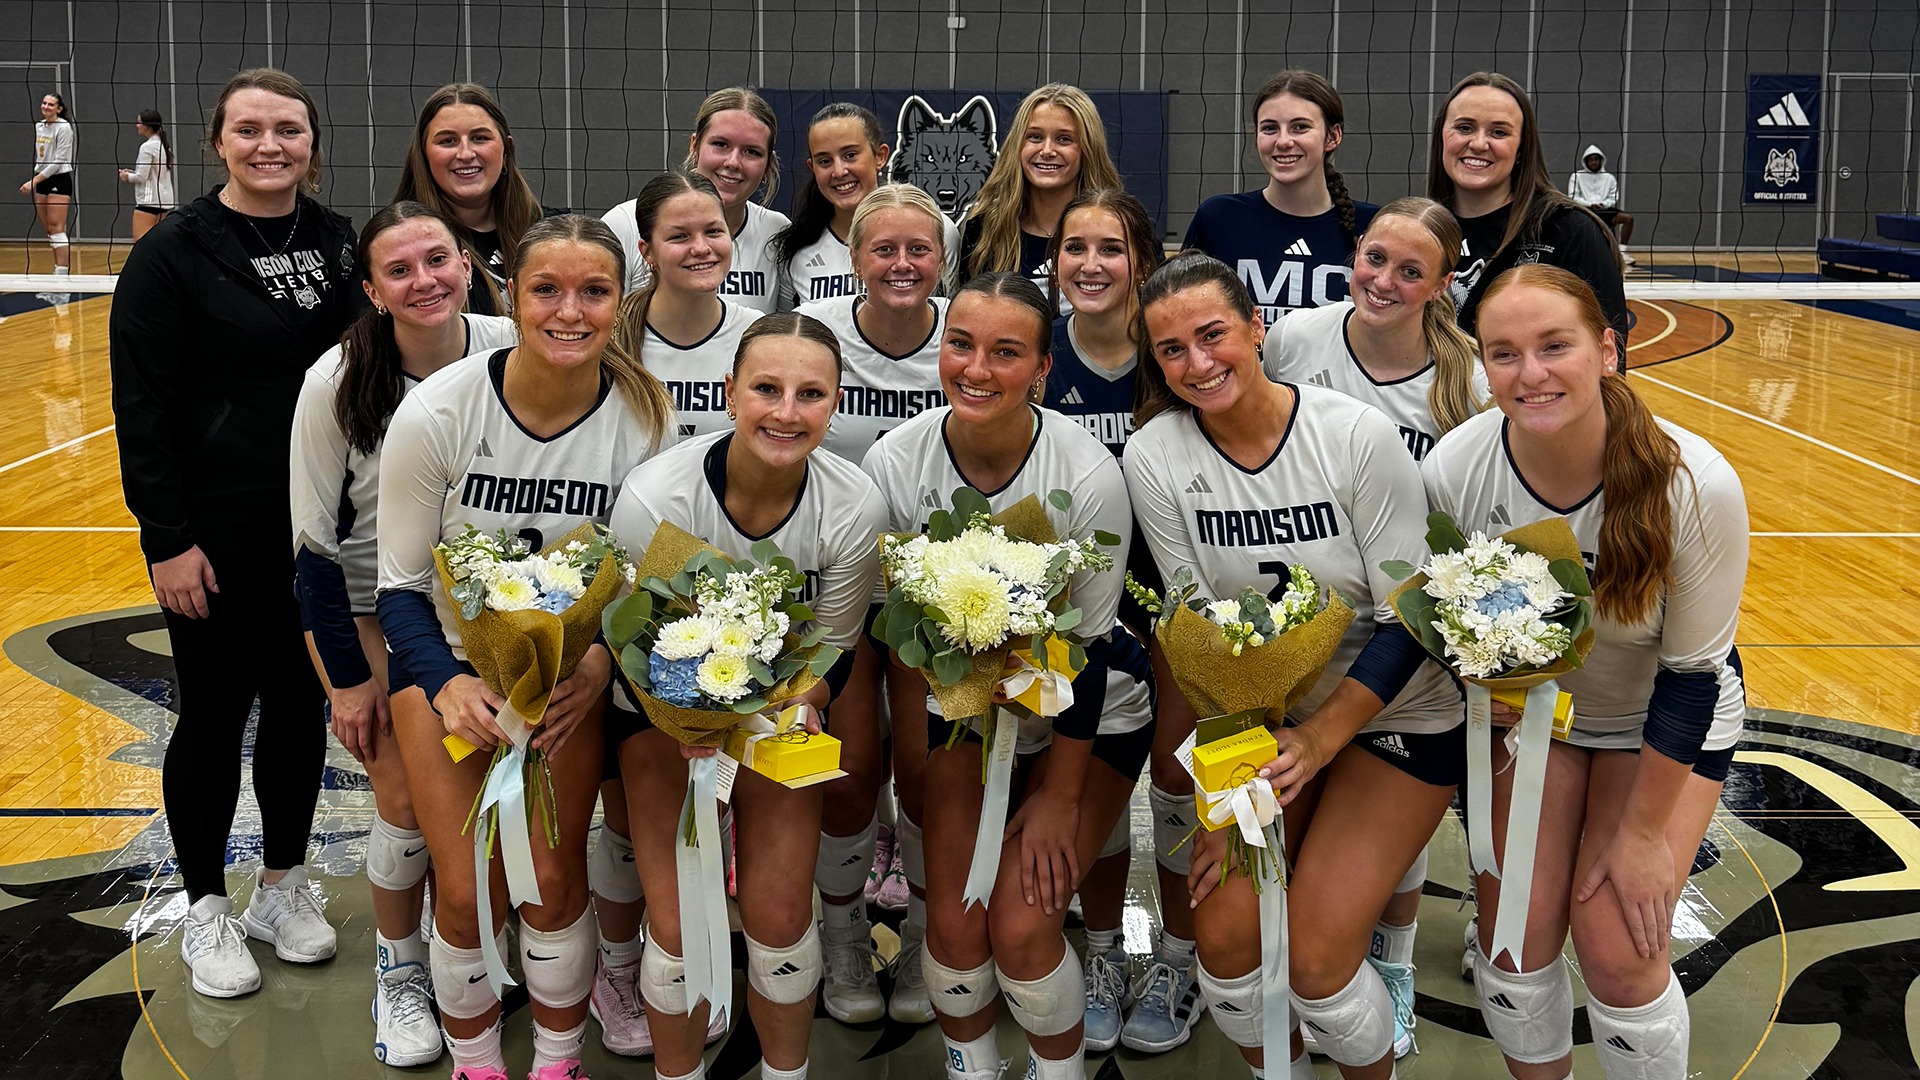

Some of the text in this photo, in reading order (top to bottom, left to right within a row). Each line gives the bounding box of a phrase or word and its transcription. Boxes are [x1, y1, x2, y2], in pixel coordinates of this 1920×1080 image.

[1754, 192, 1778, 200] OFFICIAL
[292, 249, 326, 273] COLL
[1237, 259, 1354, 307] MC
[662, 381, 727, 411] DISO
[461, 472, 609, 517] MADISON
[1194, 501, 1340, 547] MADISON
[997, 713, 1015, 762] akayla
[1206, 733, 1264, 755] KENDRA SCOTT
[1373, 739, 1410, 758] adidas
